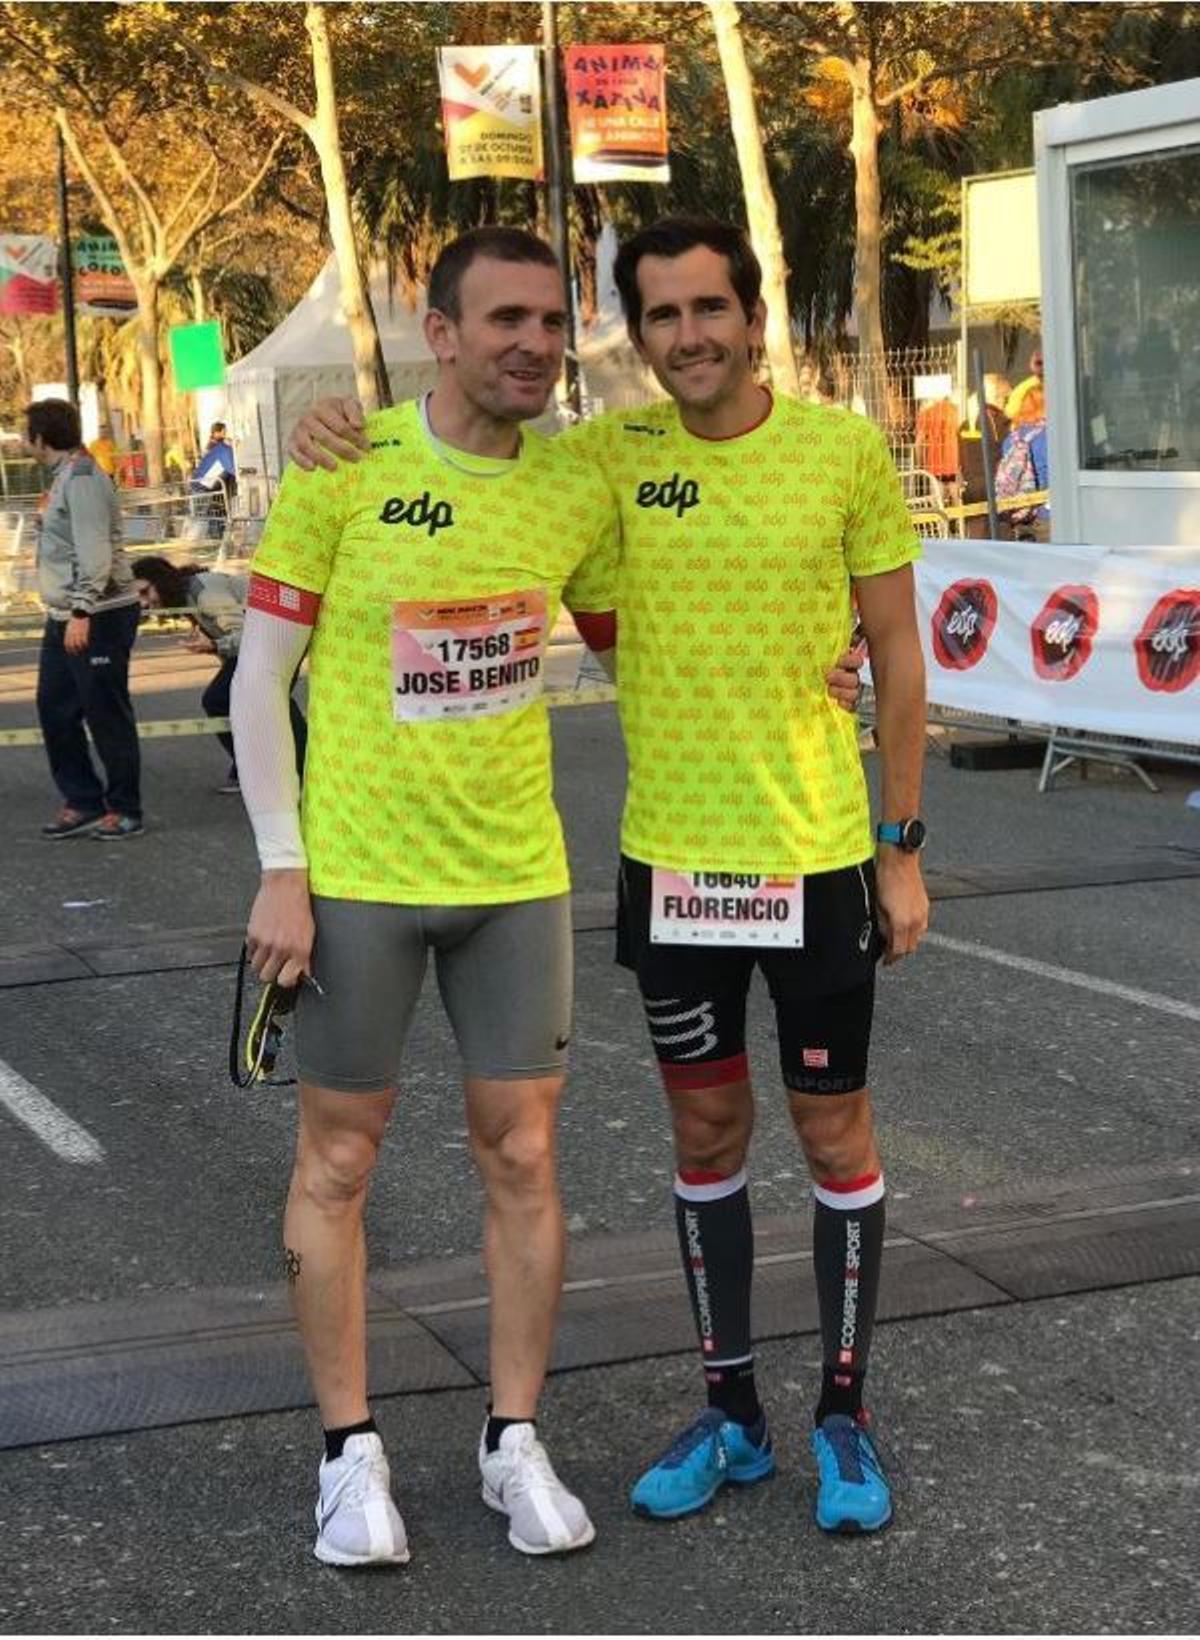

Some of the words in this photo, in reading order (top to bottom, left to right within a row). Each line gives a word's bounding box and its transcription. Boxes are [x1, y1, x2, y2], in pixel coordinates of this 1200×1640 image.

[379, 491, 454, 536] edp
[635, 473, 700, 517] edp
[947, 605, 977, 643] edp
[1044, 615, 1080, 651] edp
[1152, 621, 1189, 660] edp
[438, 633, 510, 662] 17568
[396, 671, 460, 695] JOSE
[469, 657, 540, 691] BENITO
[663, 895, 790, 921] FLORENCIO
